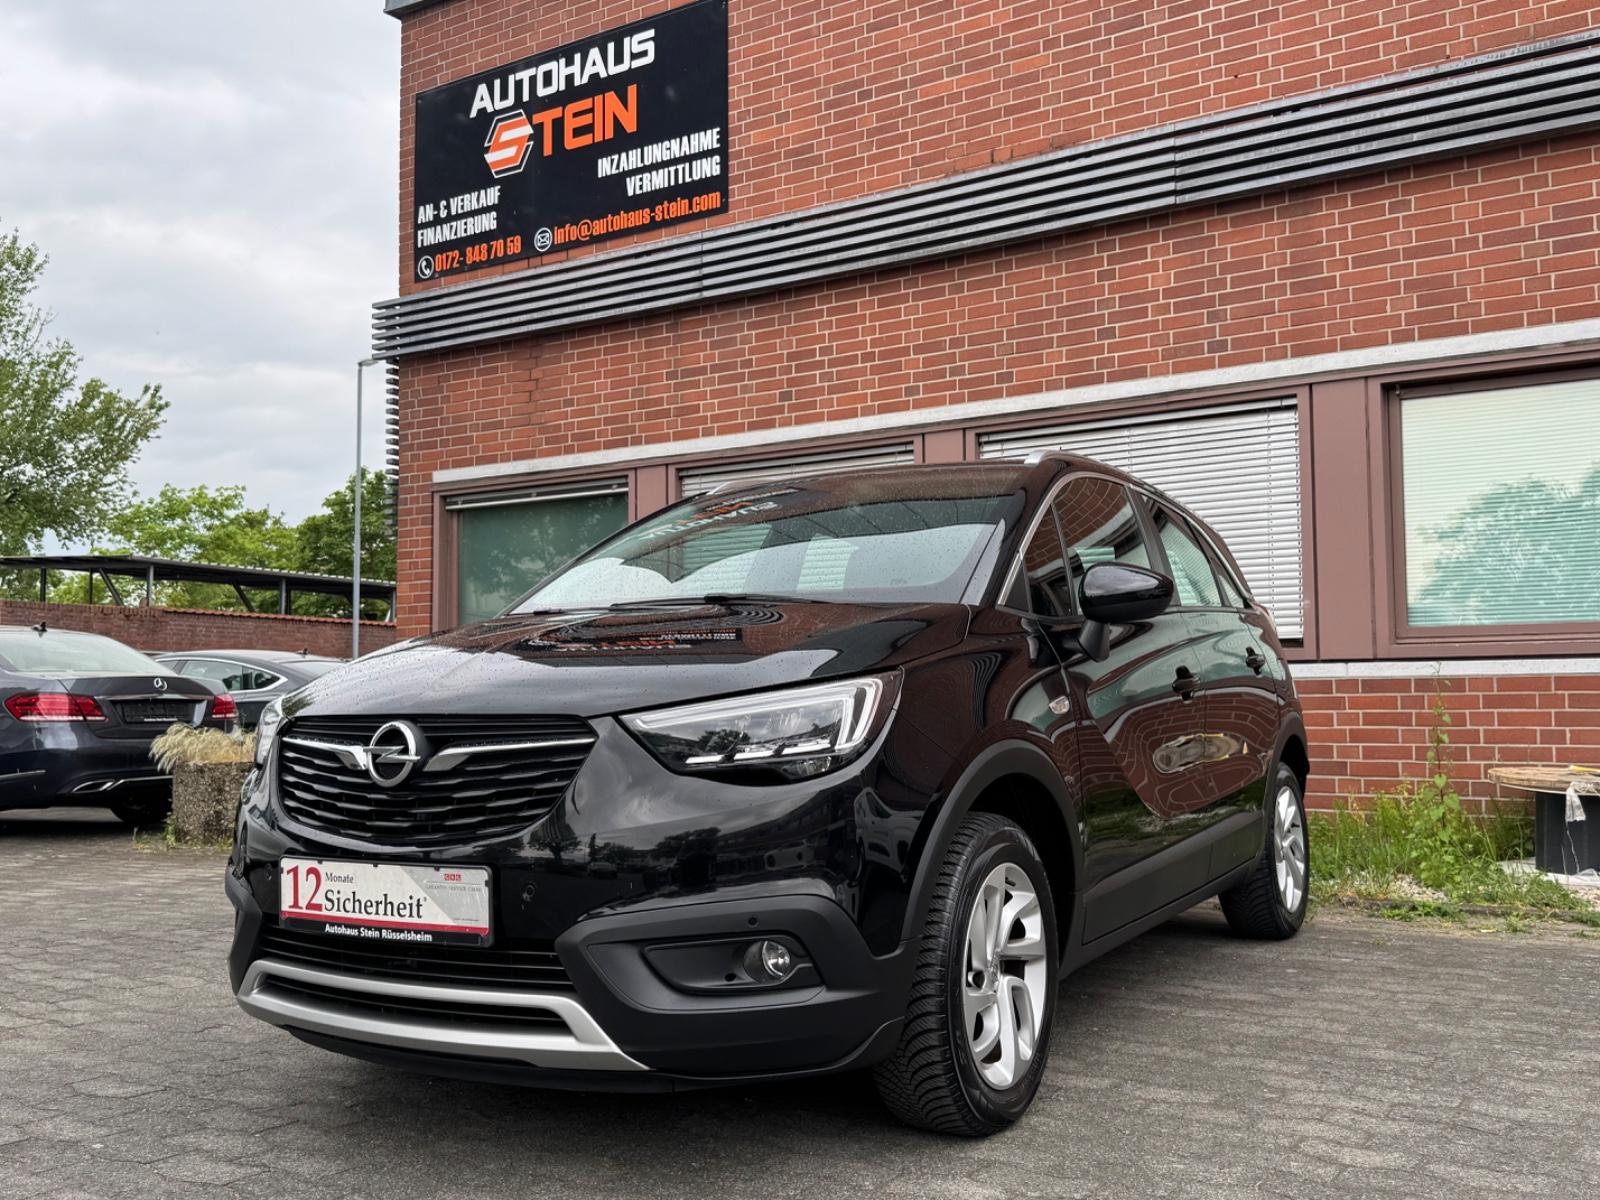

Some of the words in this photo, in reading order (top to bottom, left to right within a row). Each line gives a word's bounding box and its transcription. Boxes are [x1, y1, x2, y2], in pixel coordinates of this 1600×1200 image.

[469, 28, 655, 119] AUTOHAUS
[484, 84, 638, 172] STEIN
[597, 127, 721, 178] INZAHLUNGNAHME
[625, 155, 721, 197] VERMITTLUNG
[417, 203, 438, 224] AN-
[439, 199, 448, 218] &
[449, 185, 501, 216] VERKAUF
[553, 191, 721, 245] info@autohaus-stein.com
[417, 211, 497, 249] FINANZIERUNG
[465, 243, 488, 265] 848
[490, 239, 504, 260] 70
[286, 865, 323, 912] 12
[325, 872, 354, 884] Monate
[325, 923, 359, 936] Autohaus
[360, 928, 380, 939] Stein
[381, 929, 433, 942] Rüsselsheim
